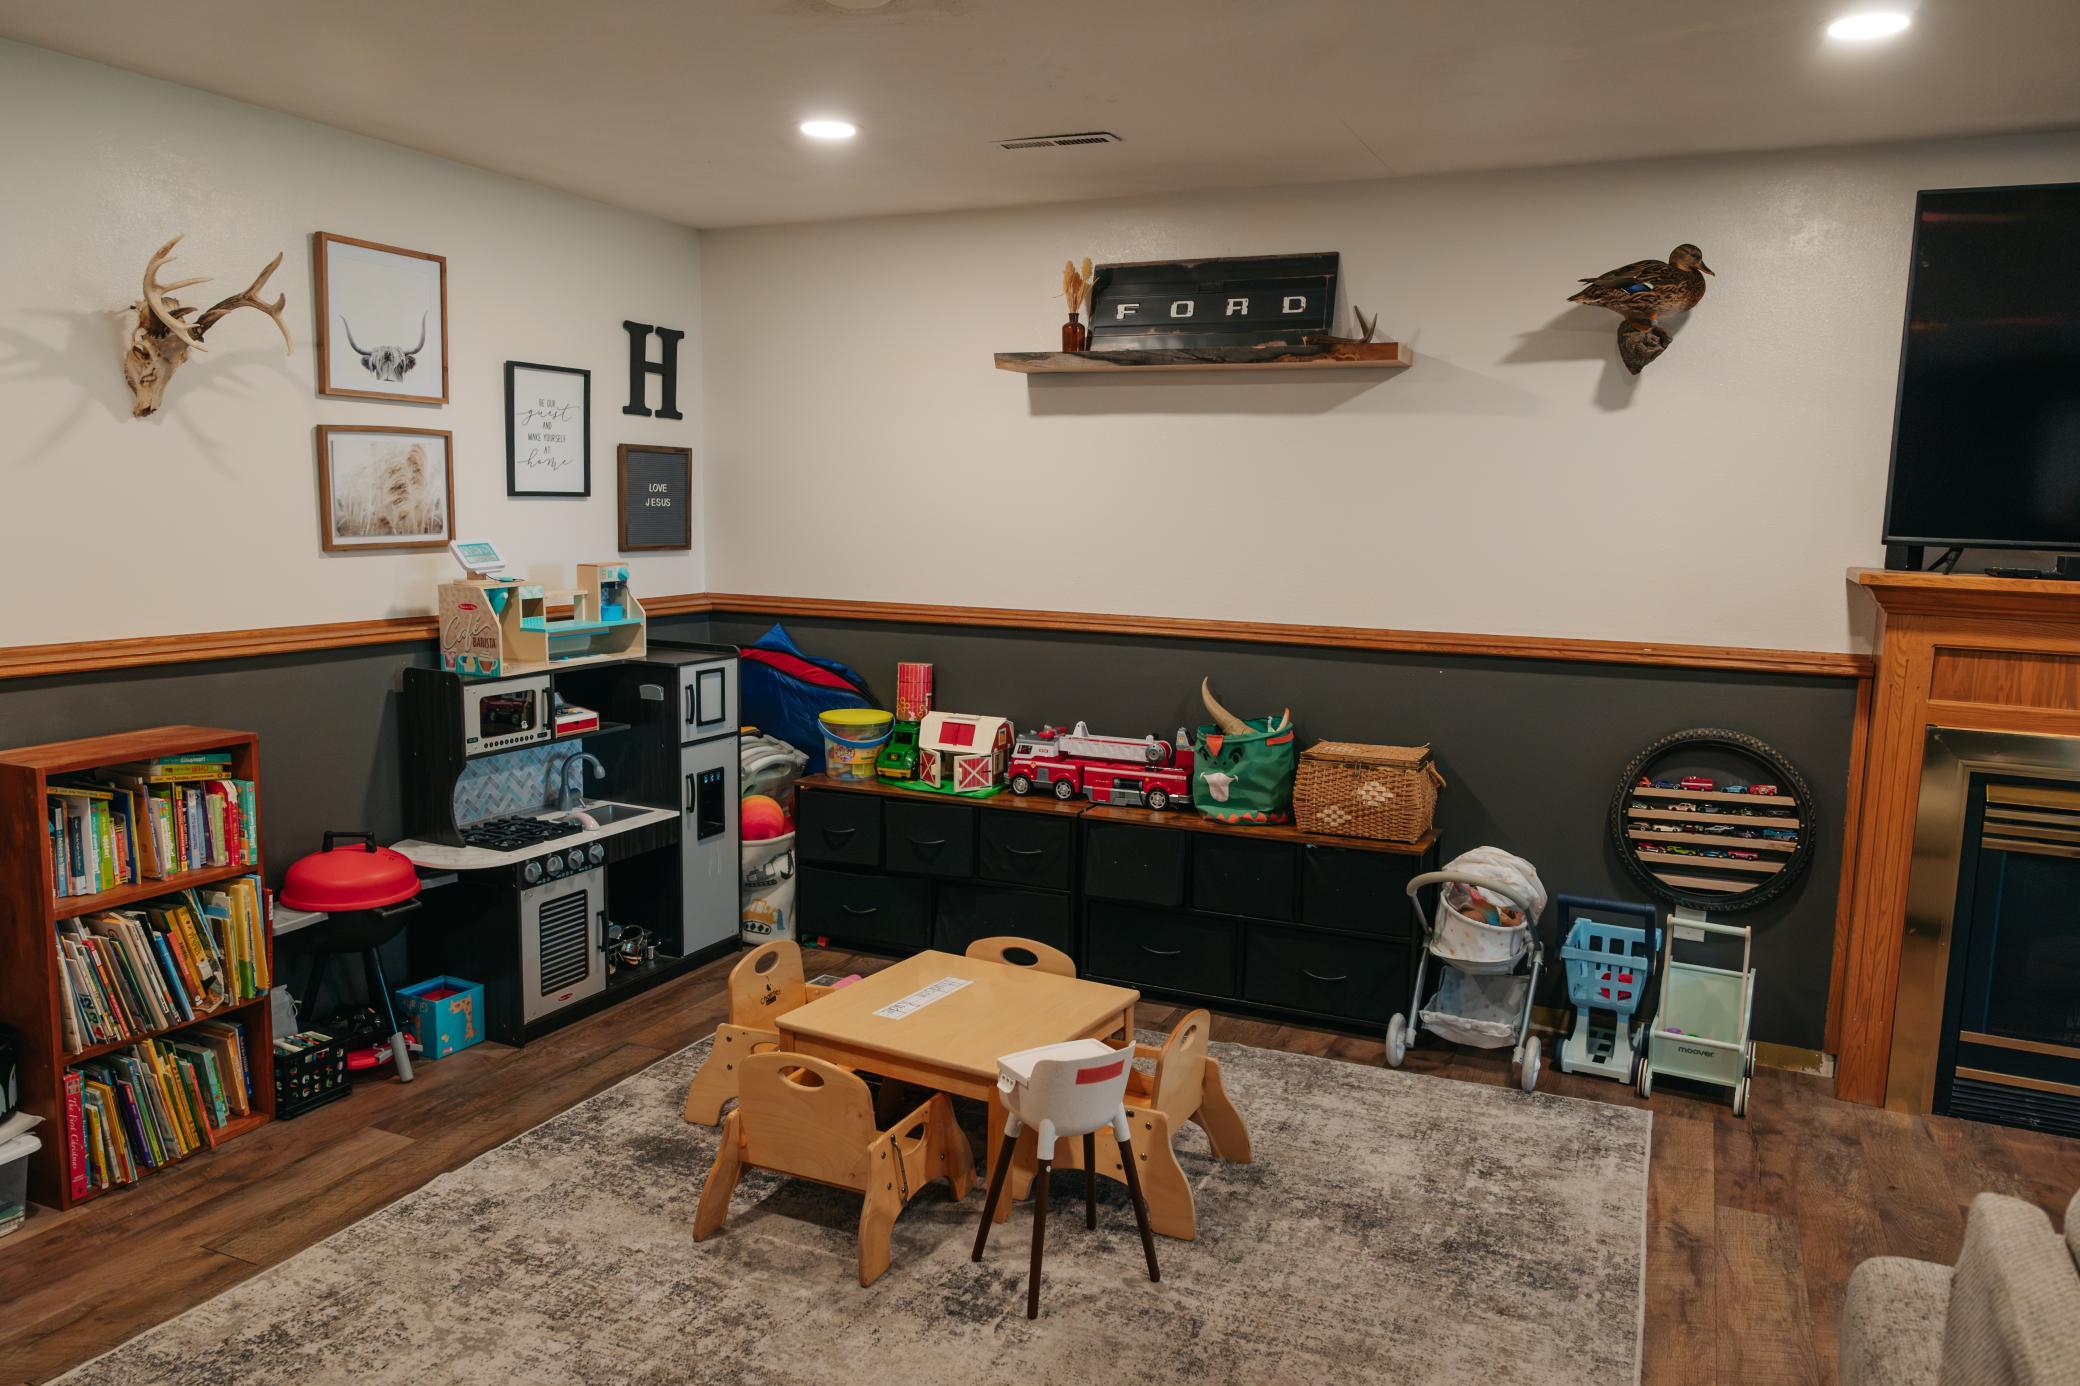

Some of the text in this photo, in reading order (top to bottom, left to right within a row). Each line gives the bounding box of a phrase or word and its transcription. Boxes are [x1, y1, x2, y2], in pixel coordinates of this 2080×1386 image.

[1116, 295, 1307, 320] FORD
[622, 319, 684, 420] H
[516, 403, 579, 426] guest
[543, 421, 552, 430] AND
[527, 433, 567, 443] MAKE YOURSELF
[544, 446, 551, 454] AT
[517, 448, 573, 471] home
[649, 483, 667, 492] LOVE
[645, 497, 671, 507] JESUS
[472, 637, 497, 649] BARISTA
[1678, 1046, 1715, 1058] moover
